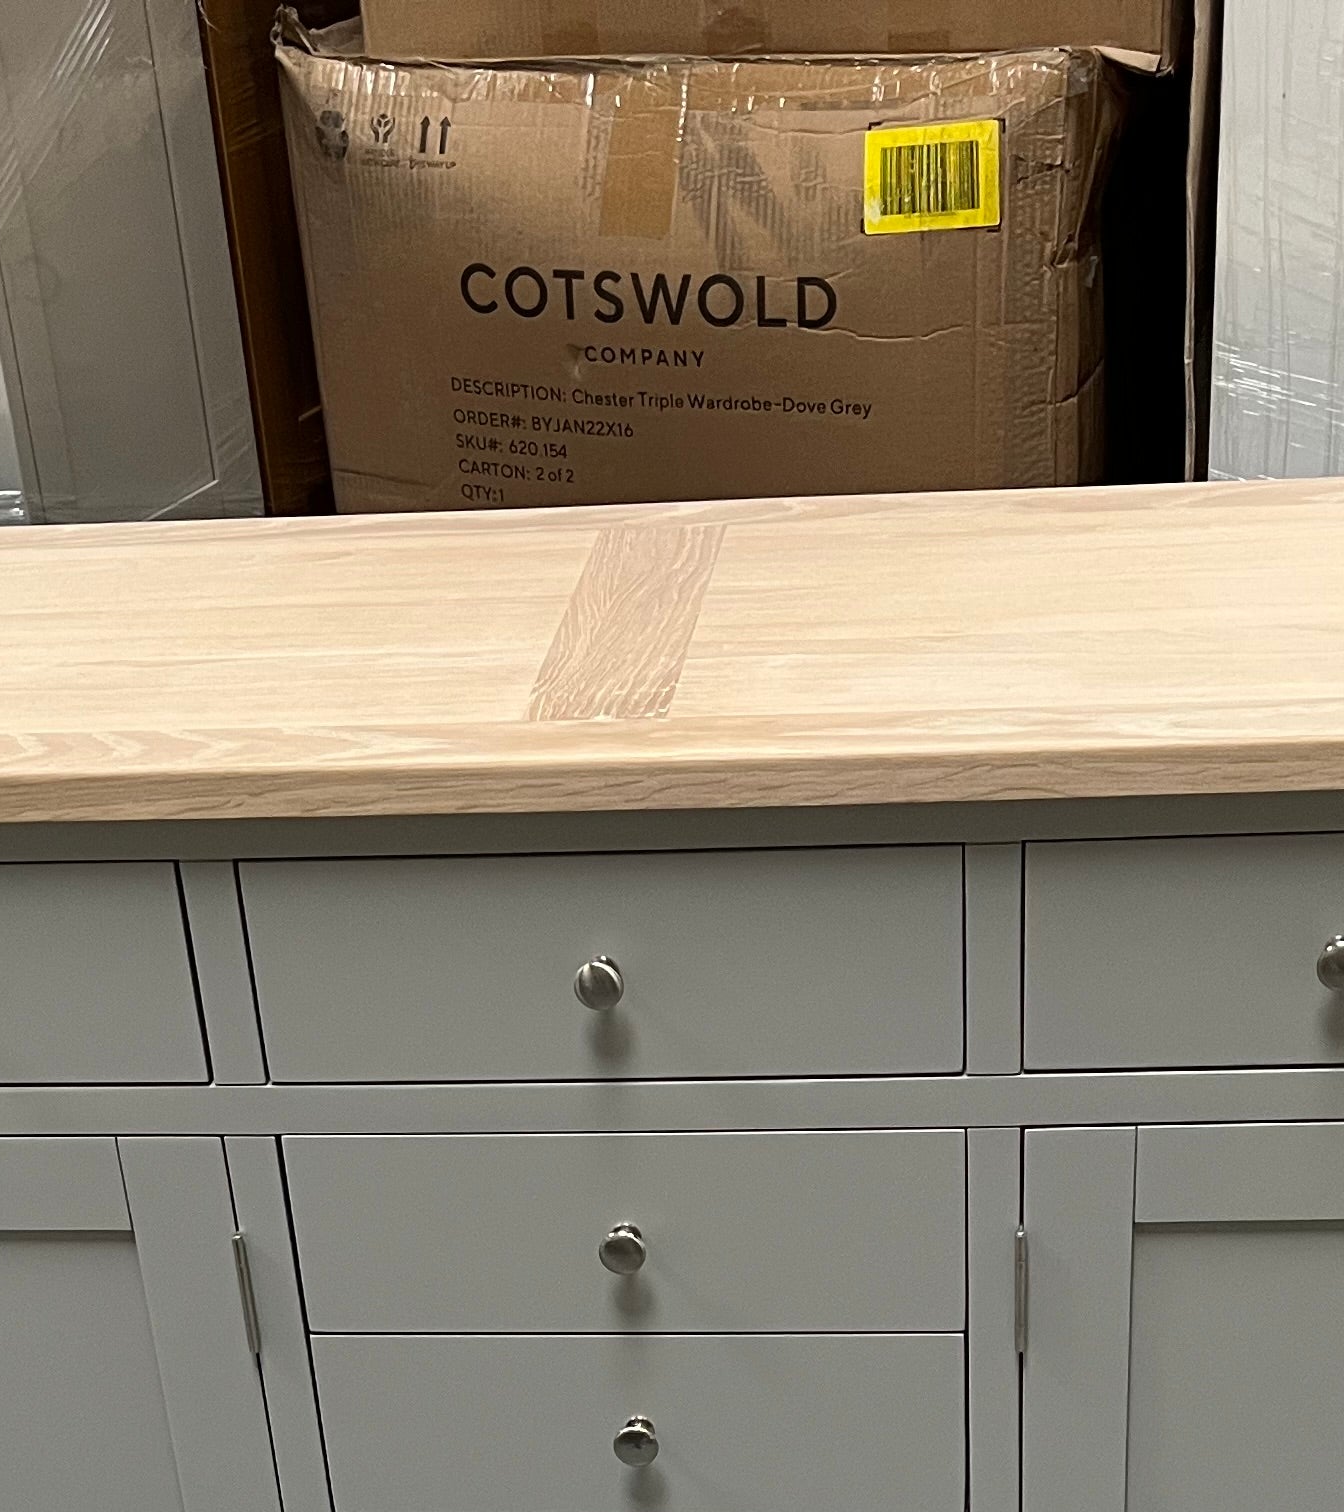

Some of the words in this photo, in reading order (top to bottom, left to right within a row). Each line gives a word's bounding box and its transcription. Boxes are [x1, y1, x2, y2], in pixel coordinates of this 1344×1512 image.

[460, 262, 837, 328] COTSWOLD
[584, 345, 705, 368] COMPANY
[450, 376, 567, 403] DESCRIPTION:
[571, 388, 635, 407] Chester
[637, 391, 684, 412] Triple
[687, 393, 827, 415] Wardrobe-Dove
[830, 398, 873, 420] Grey
[453, 408, 527, 430] ORDER#:
[531, 416, 634, 438] BYJAN22X16
[455, 432, 504, 453] SKU#:
[458, 458, 531, 481] CARTON:
[535, 466, 545, 482] 2
[548, 467, 562, 482] of
[565, 468, 575, 484] 2
